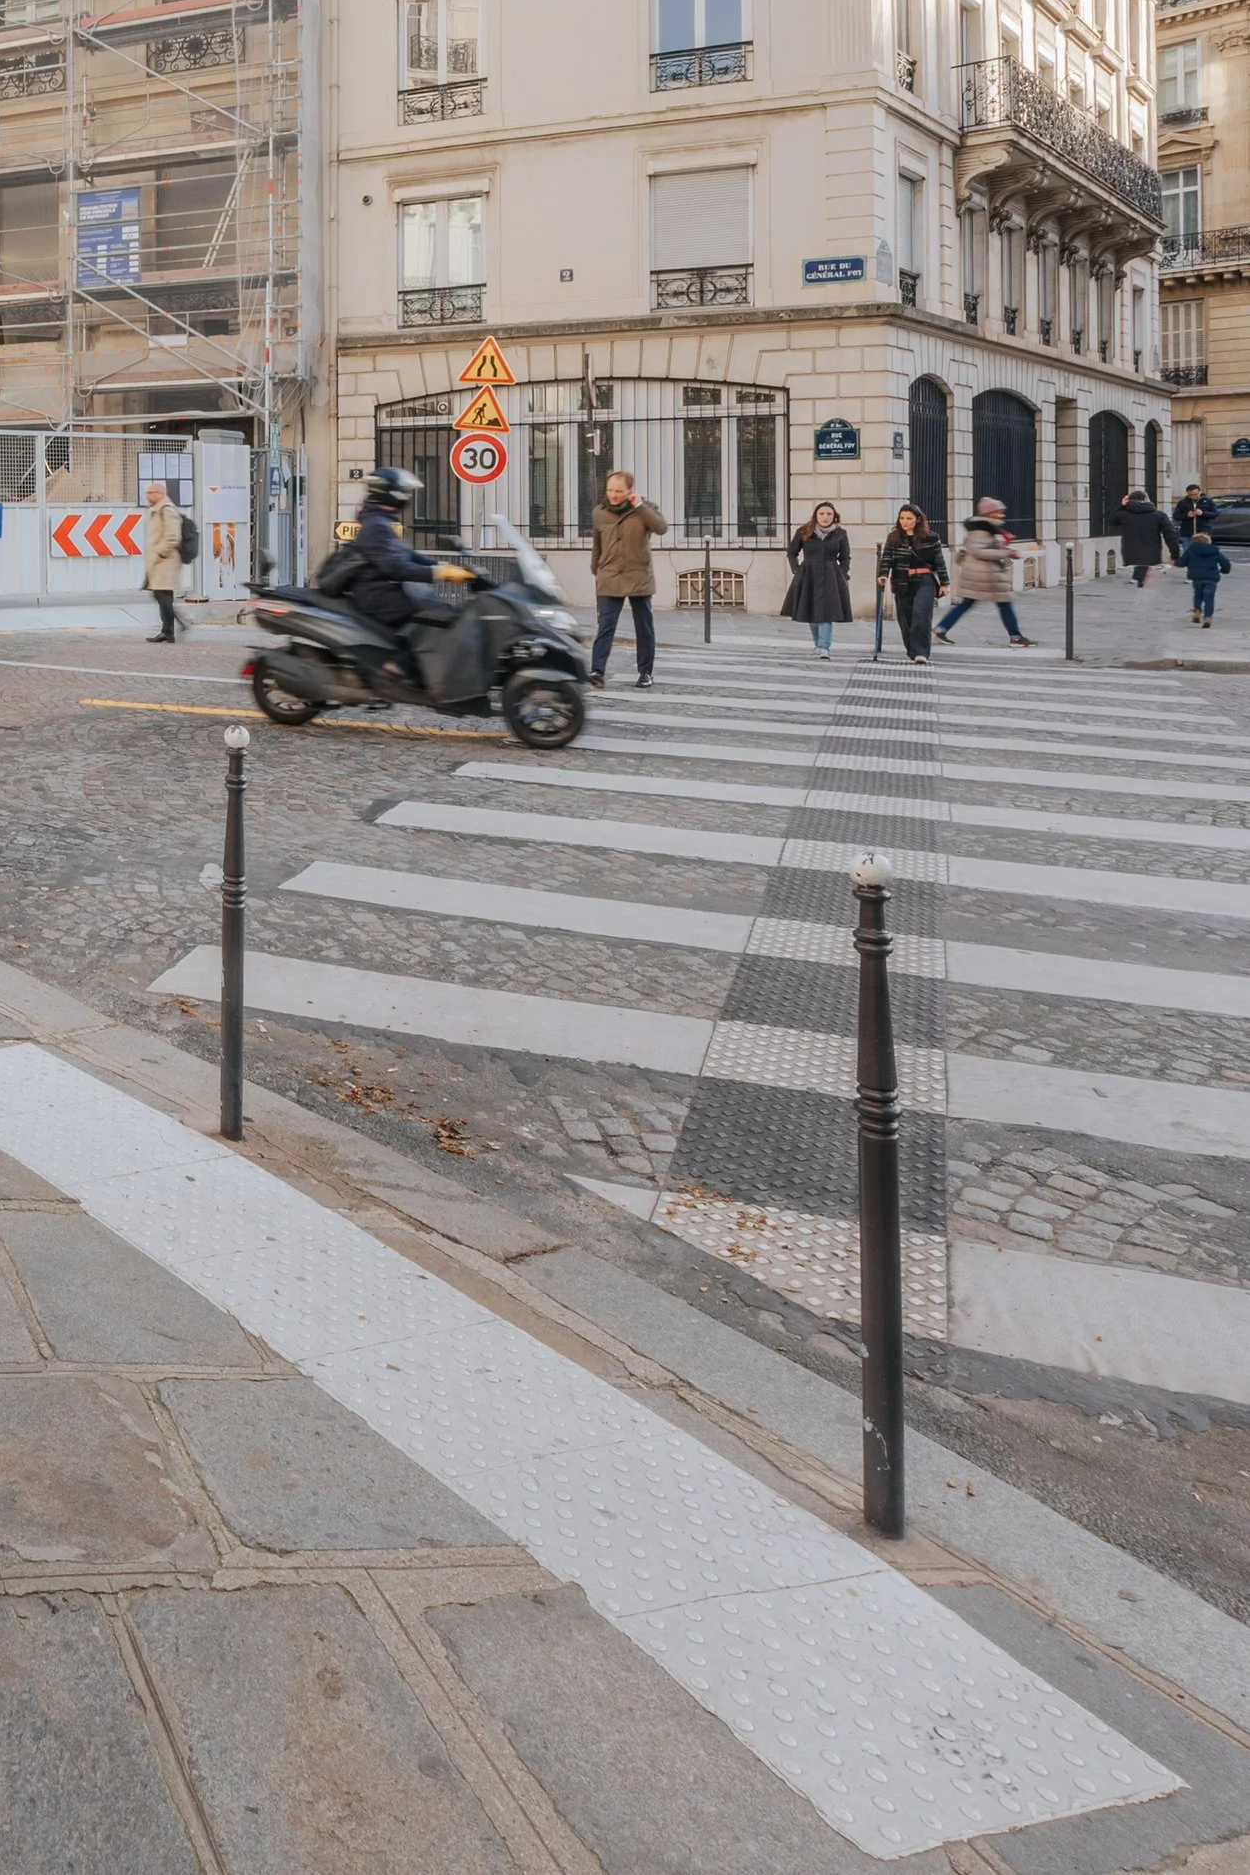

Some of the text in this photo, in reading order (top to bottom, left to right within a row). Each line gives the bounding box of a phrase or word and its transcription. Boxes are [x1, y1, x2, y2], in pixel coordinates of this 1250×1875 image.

[839, 262, 852, 270] DU
[562, 270, 571, 280] 2
[806, 269, 863, 280] GÉNÉRAL FOY
[463, 447, 497, 470] 30
[353, 470, 360, 478] 2
